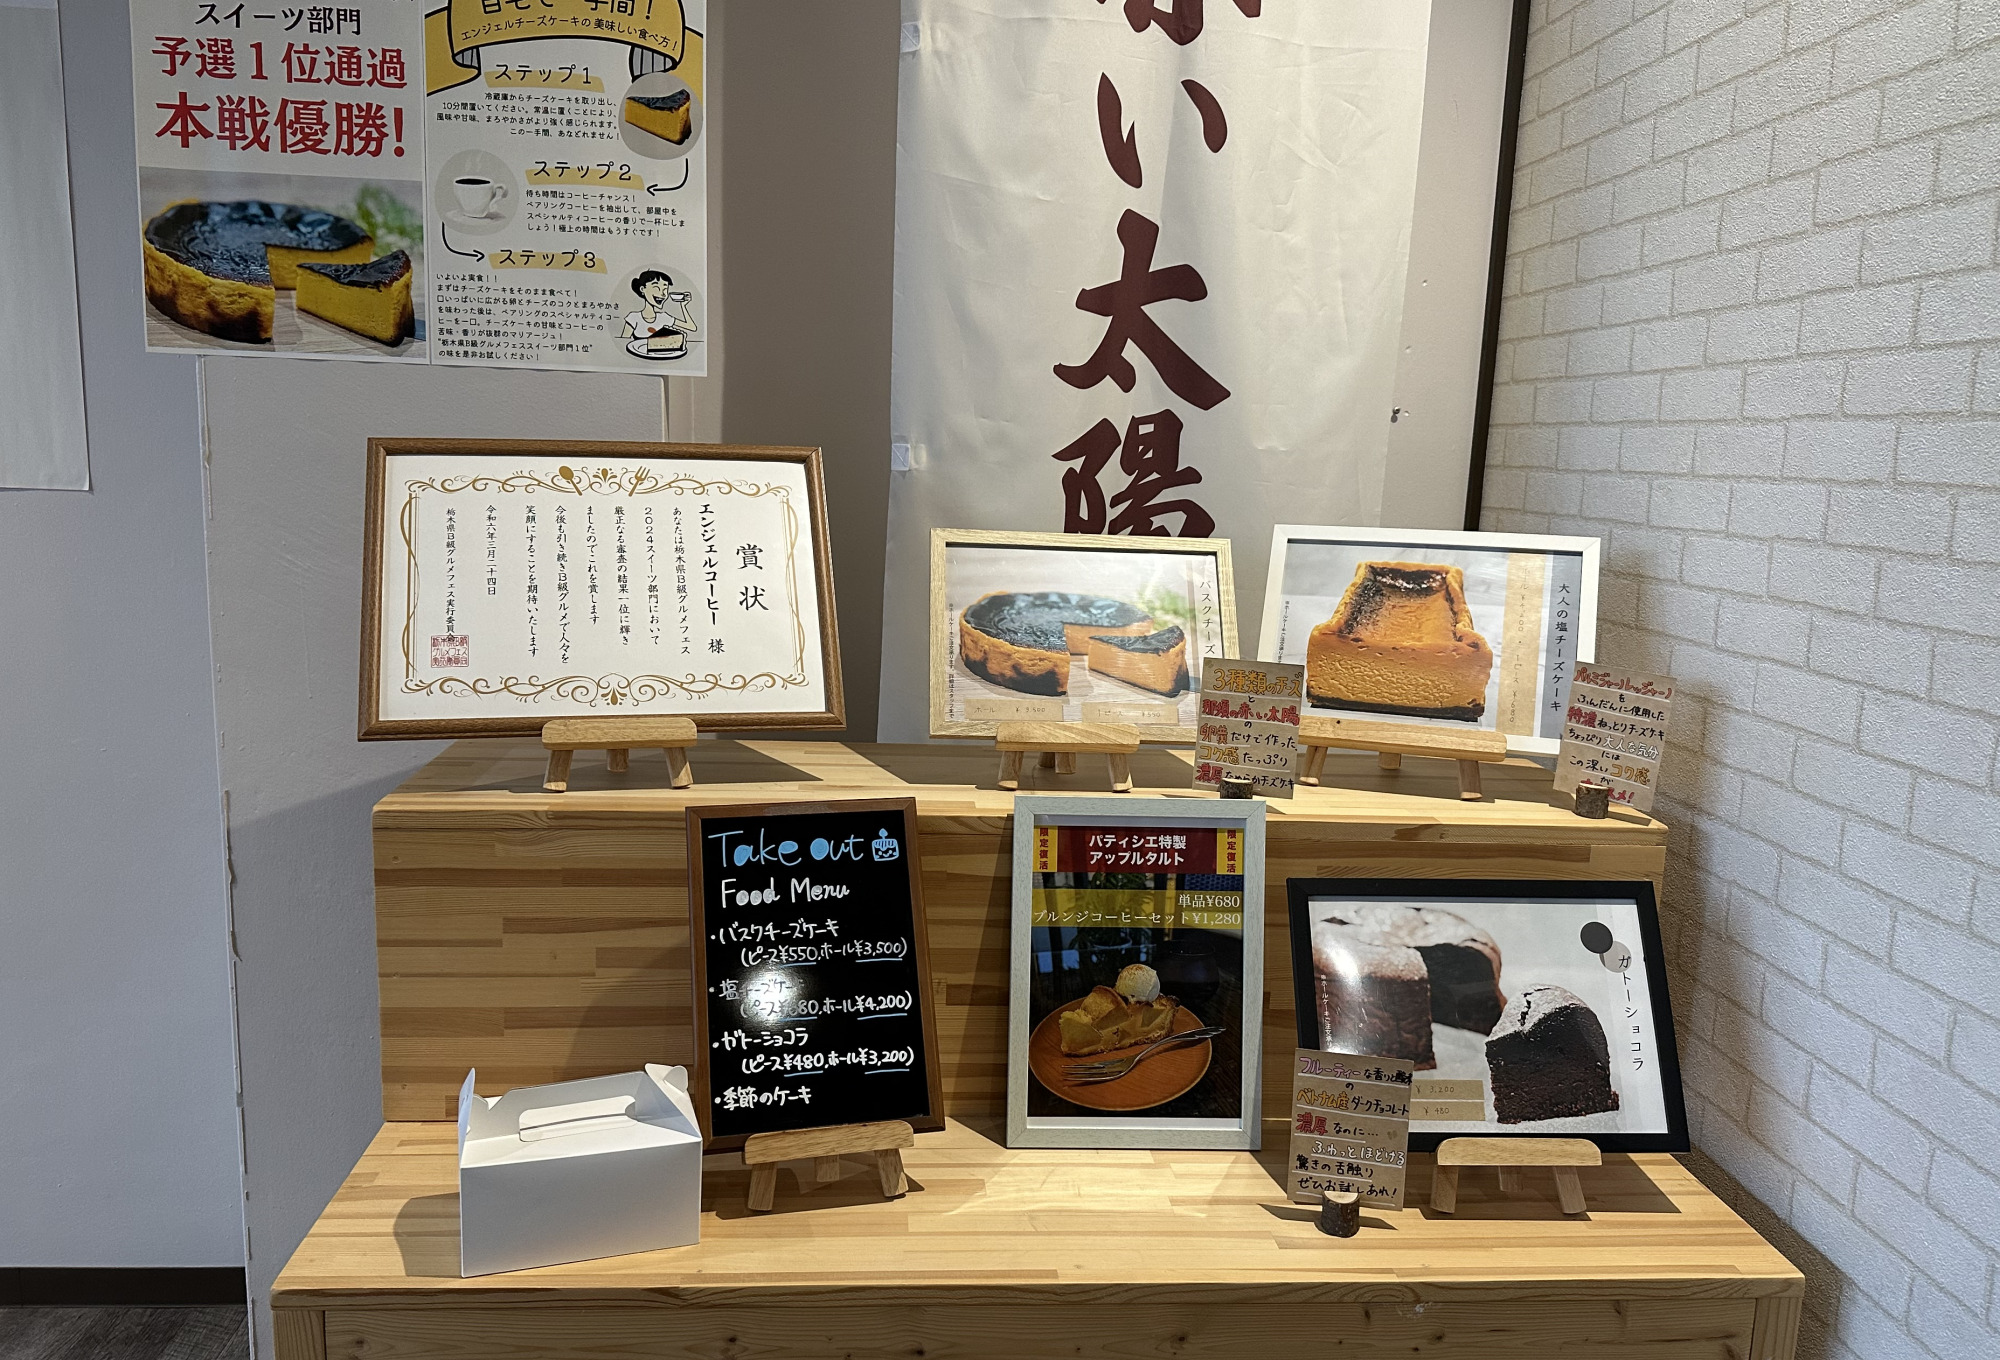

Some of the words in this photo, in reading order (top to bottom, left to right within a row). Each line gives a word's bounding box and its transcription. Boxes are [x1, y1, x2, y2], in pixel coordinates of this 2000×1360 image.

[194, 2, 361, 36] スイーツ部門
[151, 35, 408, 89] 予選1位通過
[494, 63, 592, 85] ステップ1
[155, 91, 406, 158] 本戦優勝!
[533, 160, 632, 181] ステップ2
[499, 249, 597, 269] ステップ3
[1051, 0, 1262, 538] い太陽
[485, 504, 497, 595] 令和六年三月二十四日
[586, 505, 600, 625] ましたのでこれを賞します
[699, 503, 719, 626] エンジェルコーヒー
[525, 505, 539, 657] 笑顔にすることを期待いたします
[555, 505, 570, 664] 今後も引き続きB級グルメで人々を
[614, 505, 631, 646] 厳正なる審査の結果一位に輝き
[644, 507, 660, 645] 2024スイーツ部門において
[672, 507, 691, 654] あなたは栃木県B級グルメフェス
[736, 543, 769, 611] 賞状
[1200, 581, 1215, 654] バスクチーズ
[708, 638, 725, 654] 様
[1550, 584, 1570, 711] 大人の塩チーズケーキ
[1213, 668, 1303, 697] 3種類のチーズ
[1202, 698, 1300, 726] 那須の赤い太陽
[708, 828, 801, 867] Take
[1039, 827, 1049, 870] 限定復活
[1089, 834, 1187, 850] パティシエ特製
[1089, 851, 1185, 866] アップルタルト
[1226, 829, 1237, 874] 限定復活
[722, 877, 780, 908] Food
[790, 877, 850, 903] Menu
[1618, 955, 1643, 1071] ガトーショコラ
[1297, 1087, 1409, 1116] ベトナム産ダークチョコレート
[1345, 1082, 1354, 1091] の
[1312, 1140, 1405, 1166] ふわっとほどける
